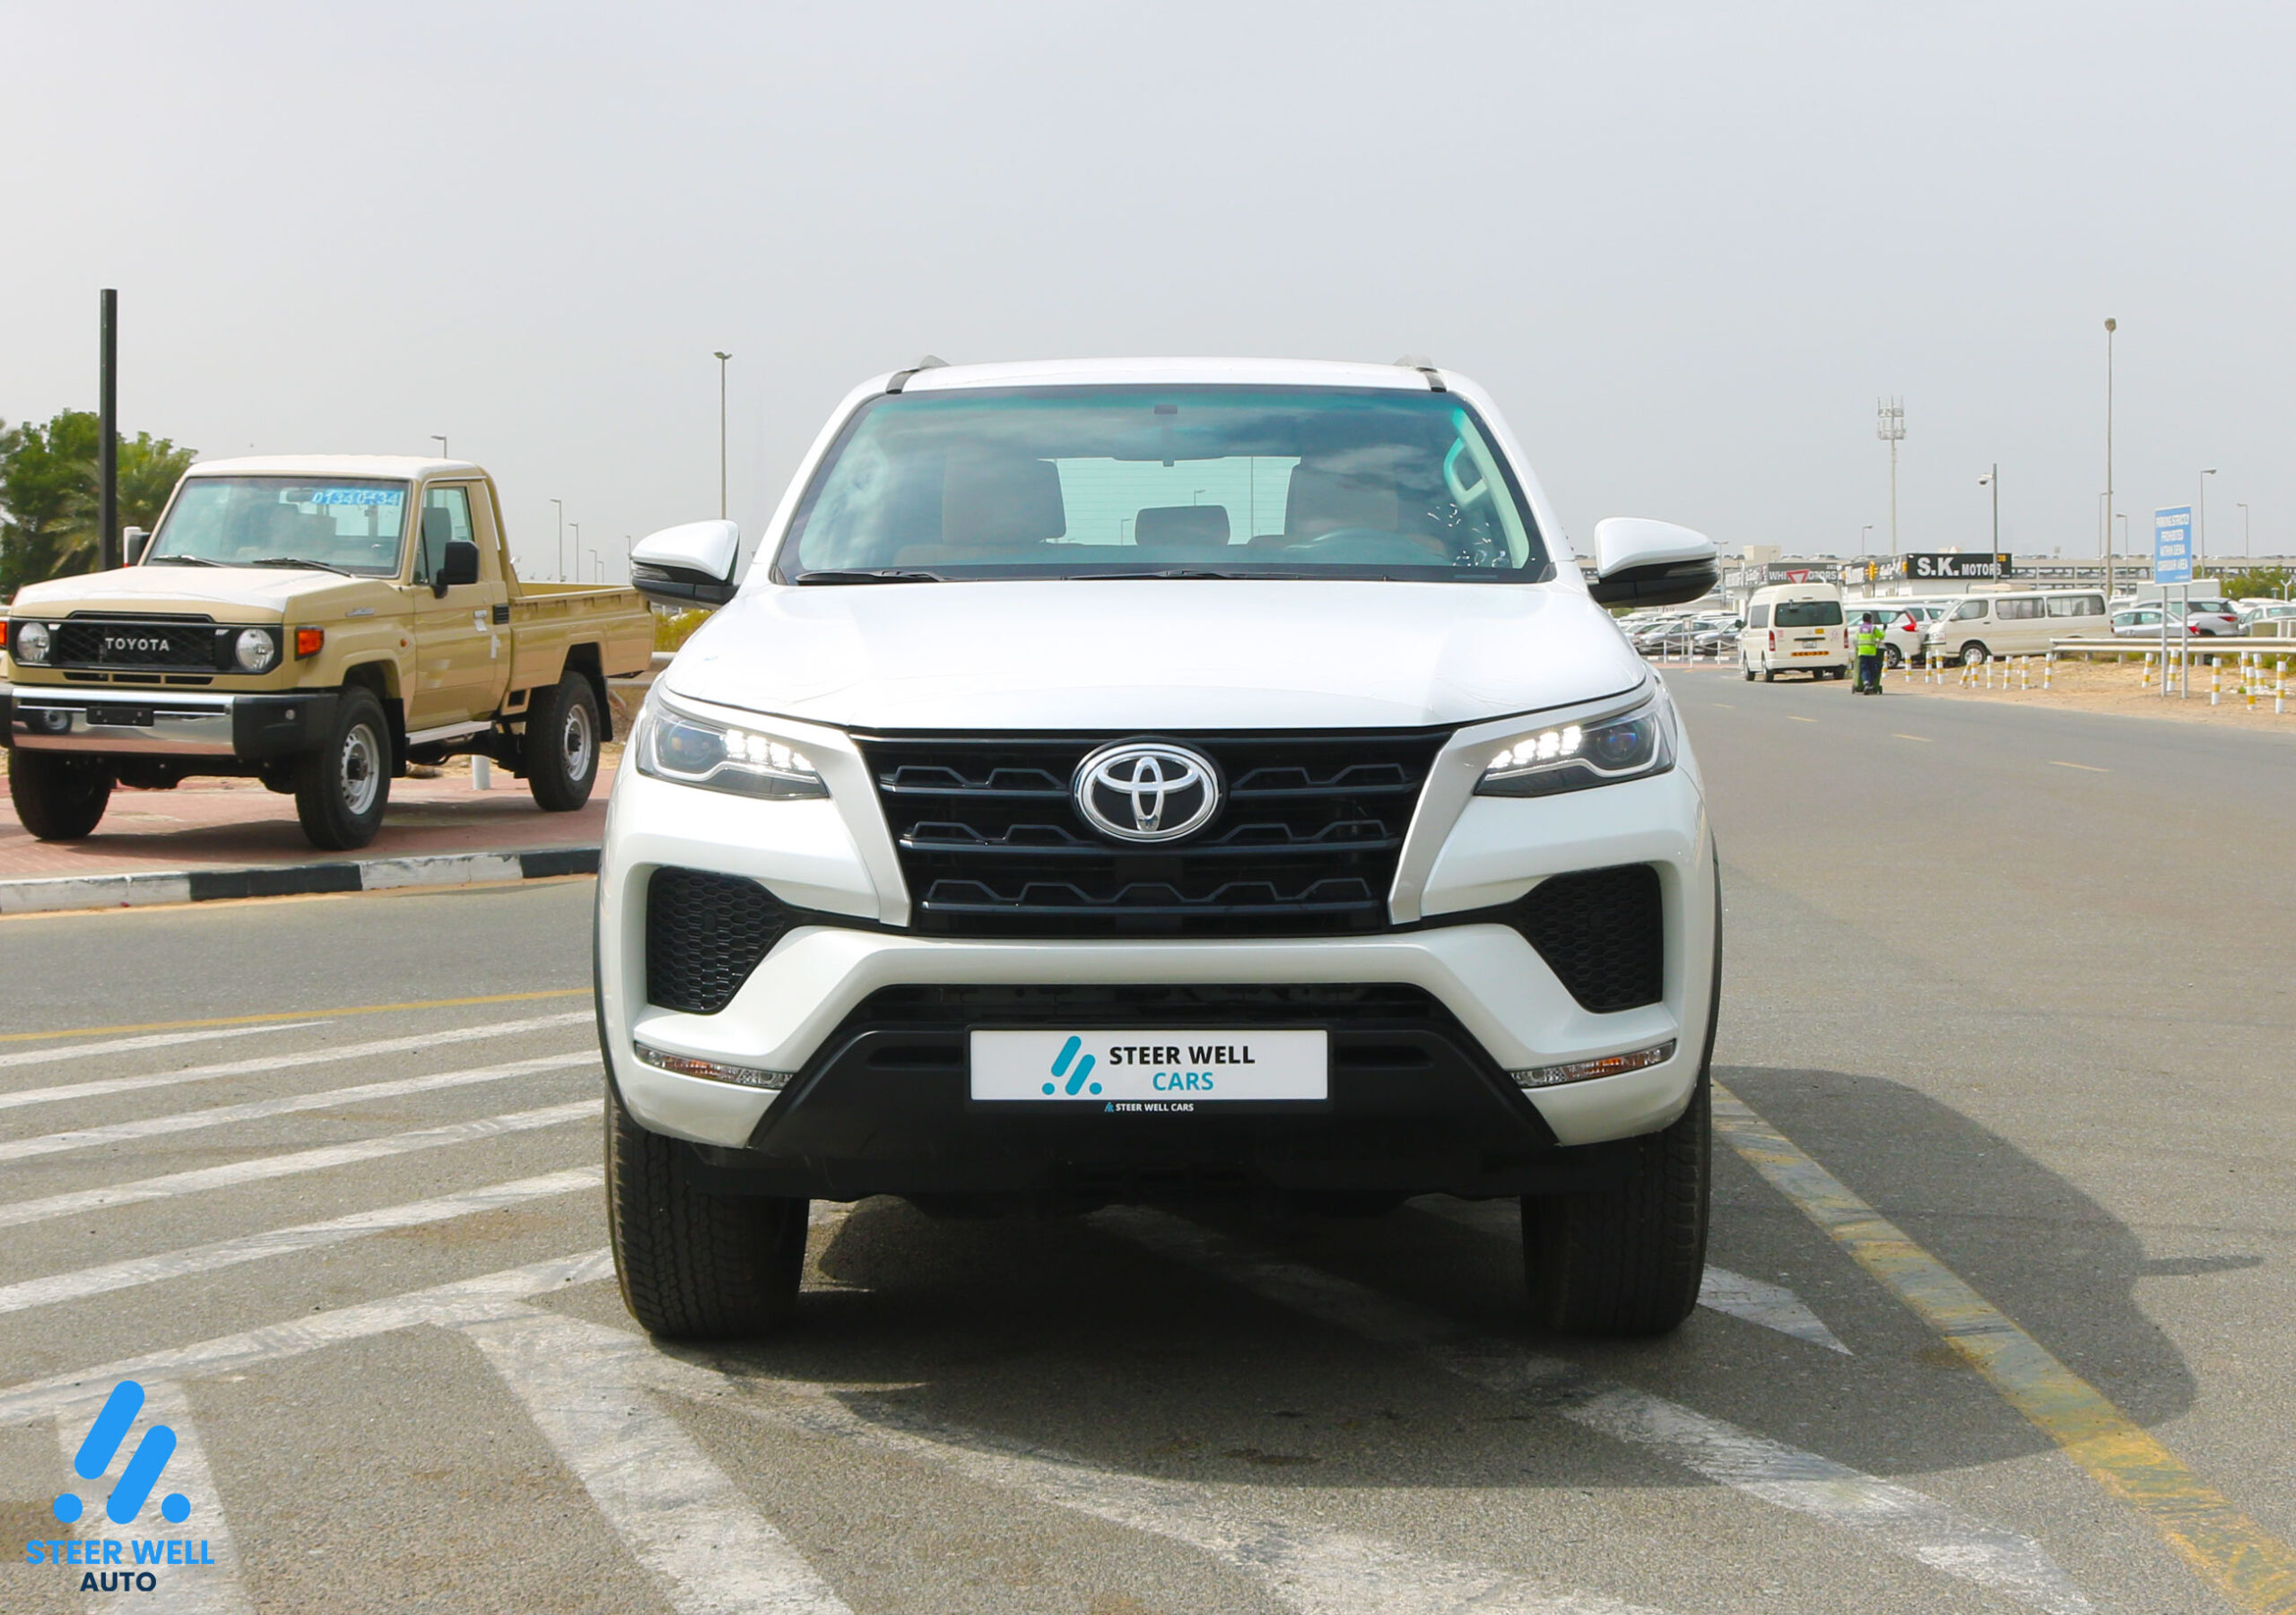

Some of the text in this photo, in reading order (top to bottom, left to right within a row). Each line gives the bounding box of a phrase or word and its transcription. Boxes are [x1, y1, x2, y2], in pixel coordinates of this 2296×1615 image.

[1917, 557, 1960, 577] S.K.
[105, 638, 170, 652] TOYOTA
[1109, 1046, 1256, 1065] STEER WELL
[1152, 1072, 1213, 1091] CARS
[1115, 1103, 1195, 1112] STEER WELL CARS
